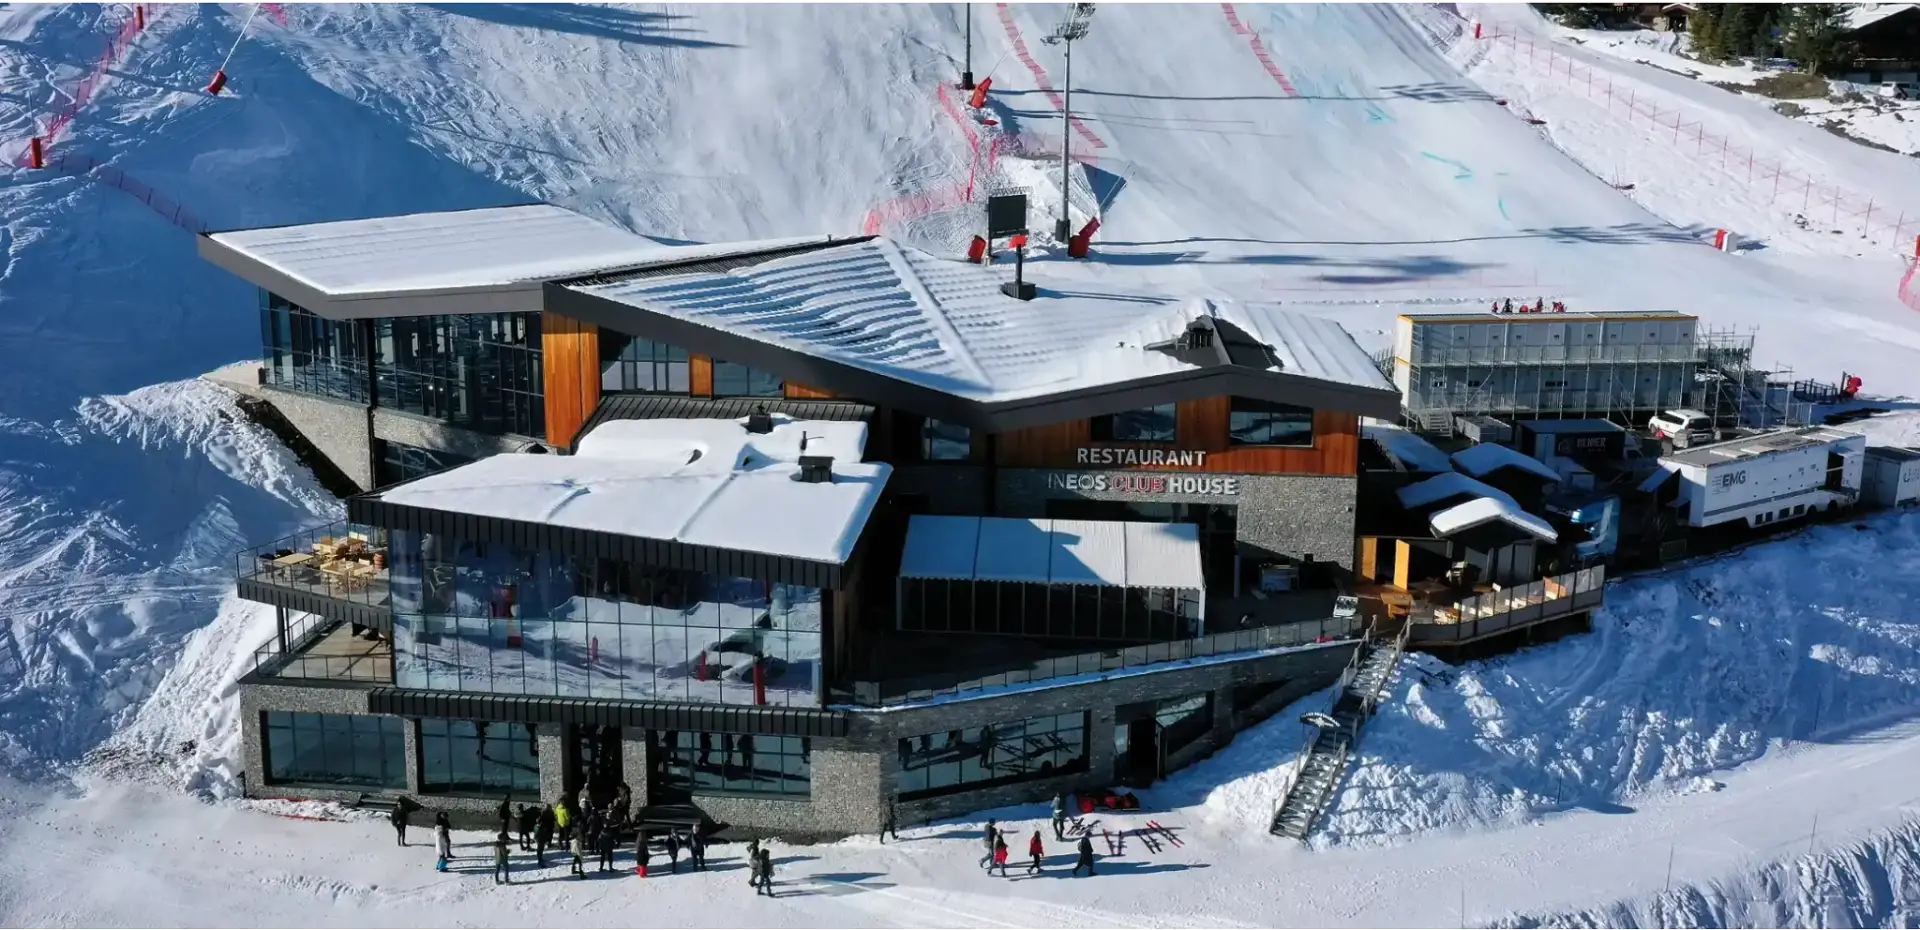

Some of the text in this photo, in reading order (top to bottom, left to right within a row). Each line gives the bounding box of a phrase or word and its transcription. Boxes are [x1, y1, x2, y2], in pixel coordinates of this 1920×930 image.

[1077, 448, 1206, 466] RESTAURANT
[1047, 473, 1236, 495] INEOS CLUB HOUSE
[1722, 470, 1746, 487] EMG
